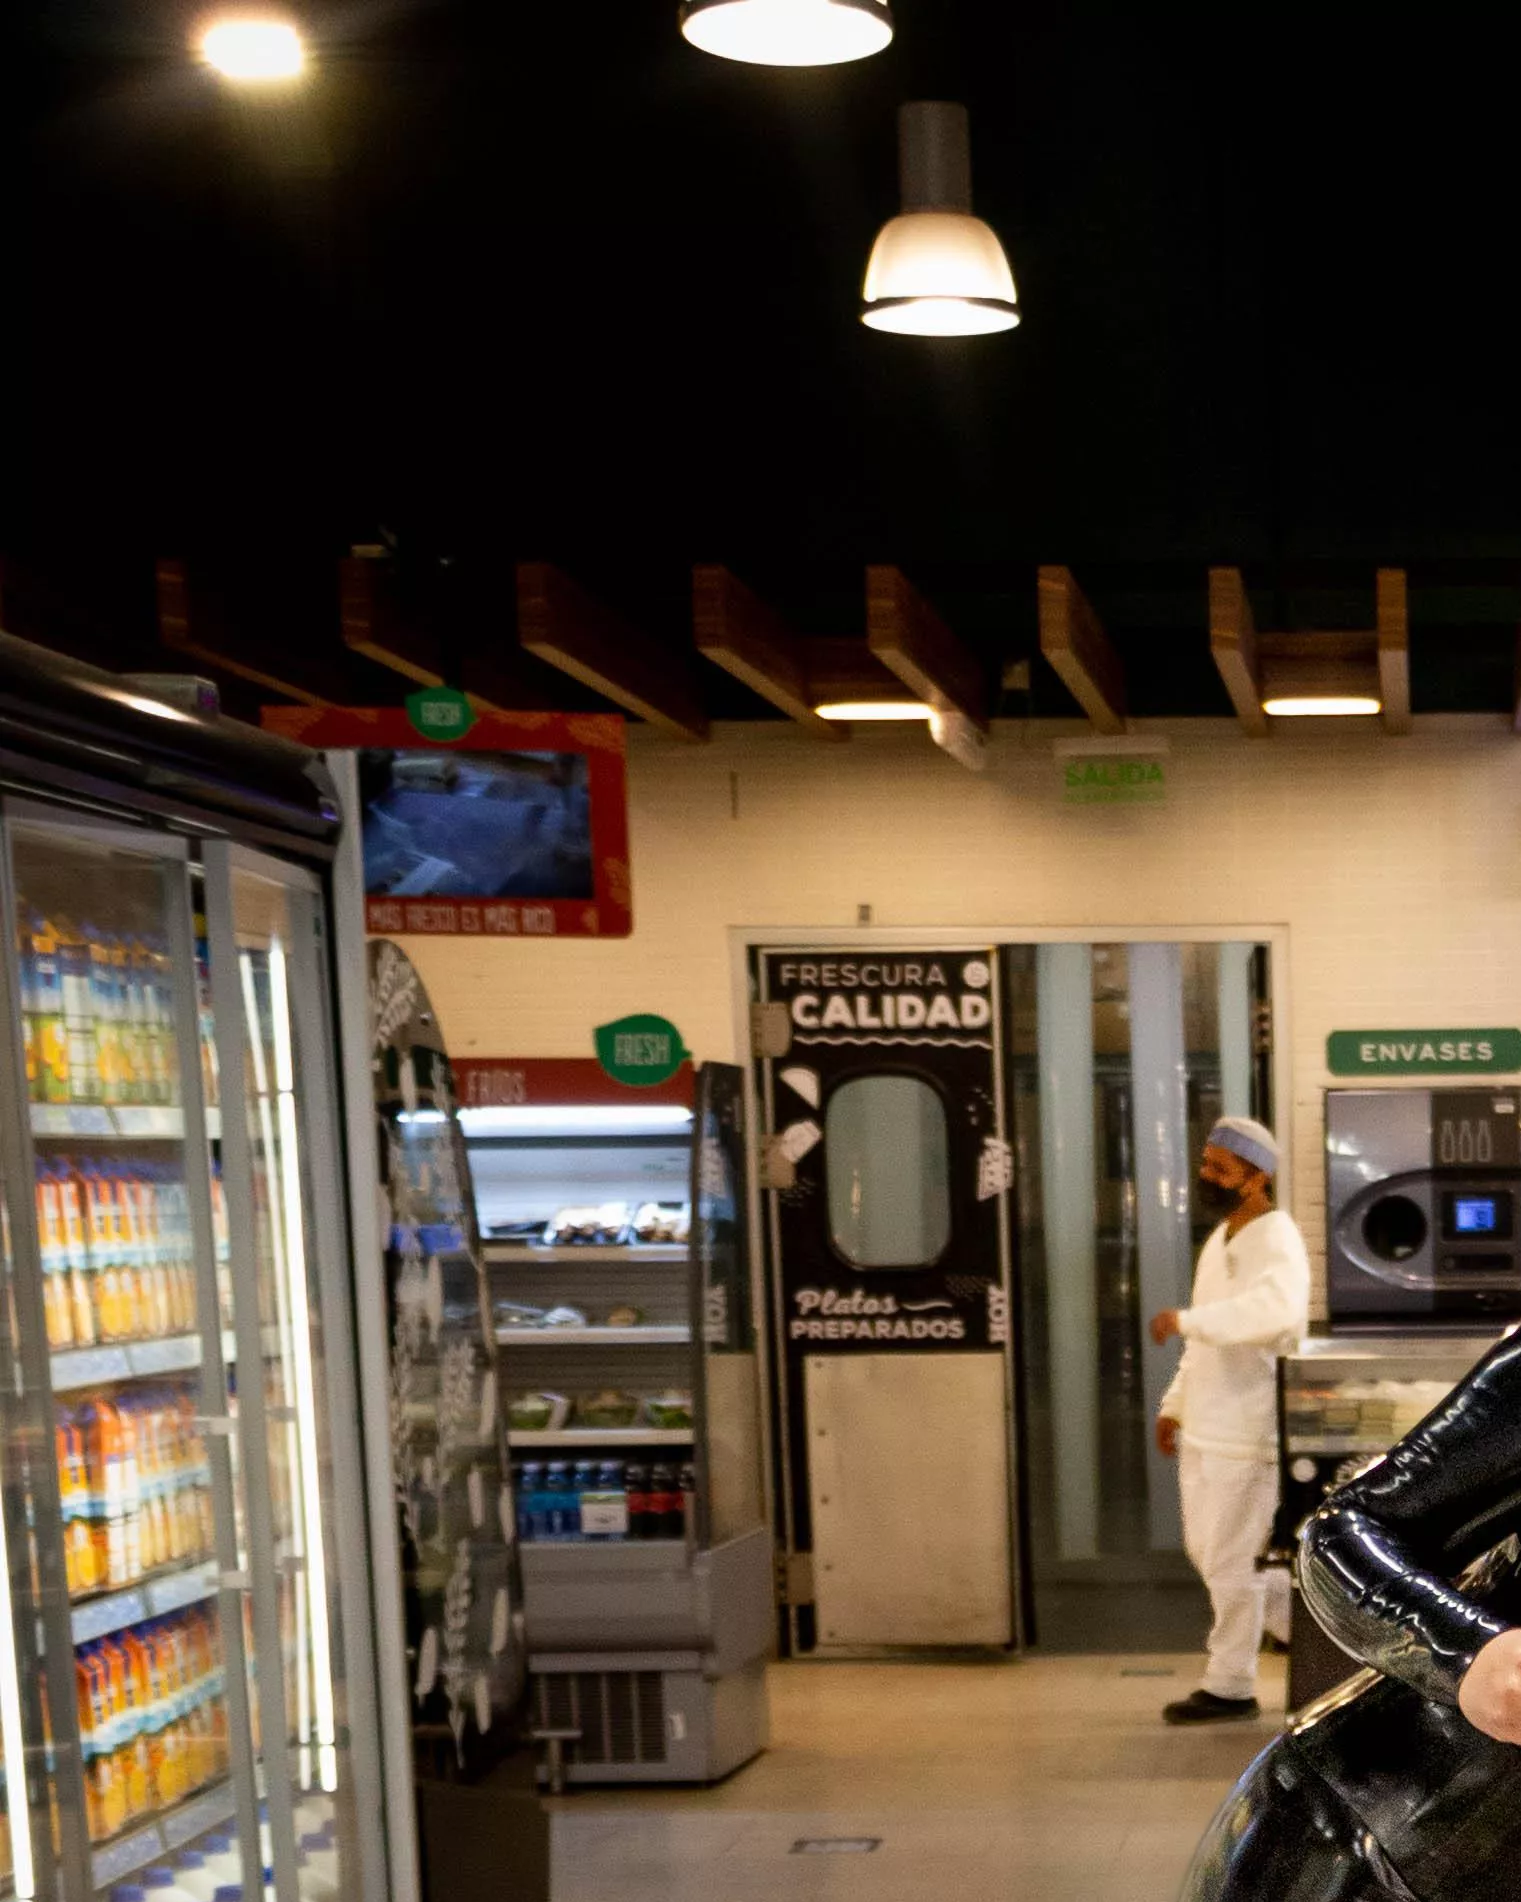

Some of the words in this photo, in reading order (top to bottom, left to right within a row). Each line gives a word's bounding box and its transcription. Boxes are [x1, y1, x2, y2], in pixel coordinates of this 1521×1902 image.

[1065, 762, 1163, 787] SALIDA
[780, 963, 948, 987] FRESCURA
[792, 993, 991, 1029] CALIDAD
[1360, 1041, 1493, 1062] ENVASES
[794, 1287, 899, 1316] Platos
[791, 1318, 966, 1340] PREPARADOS
